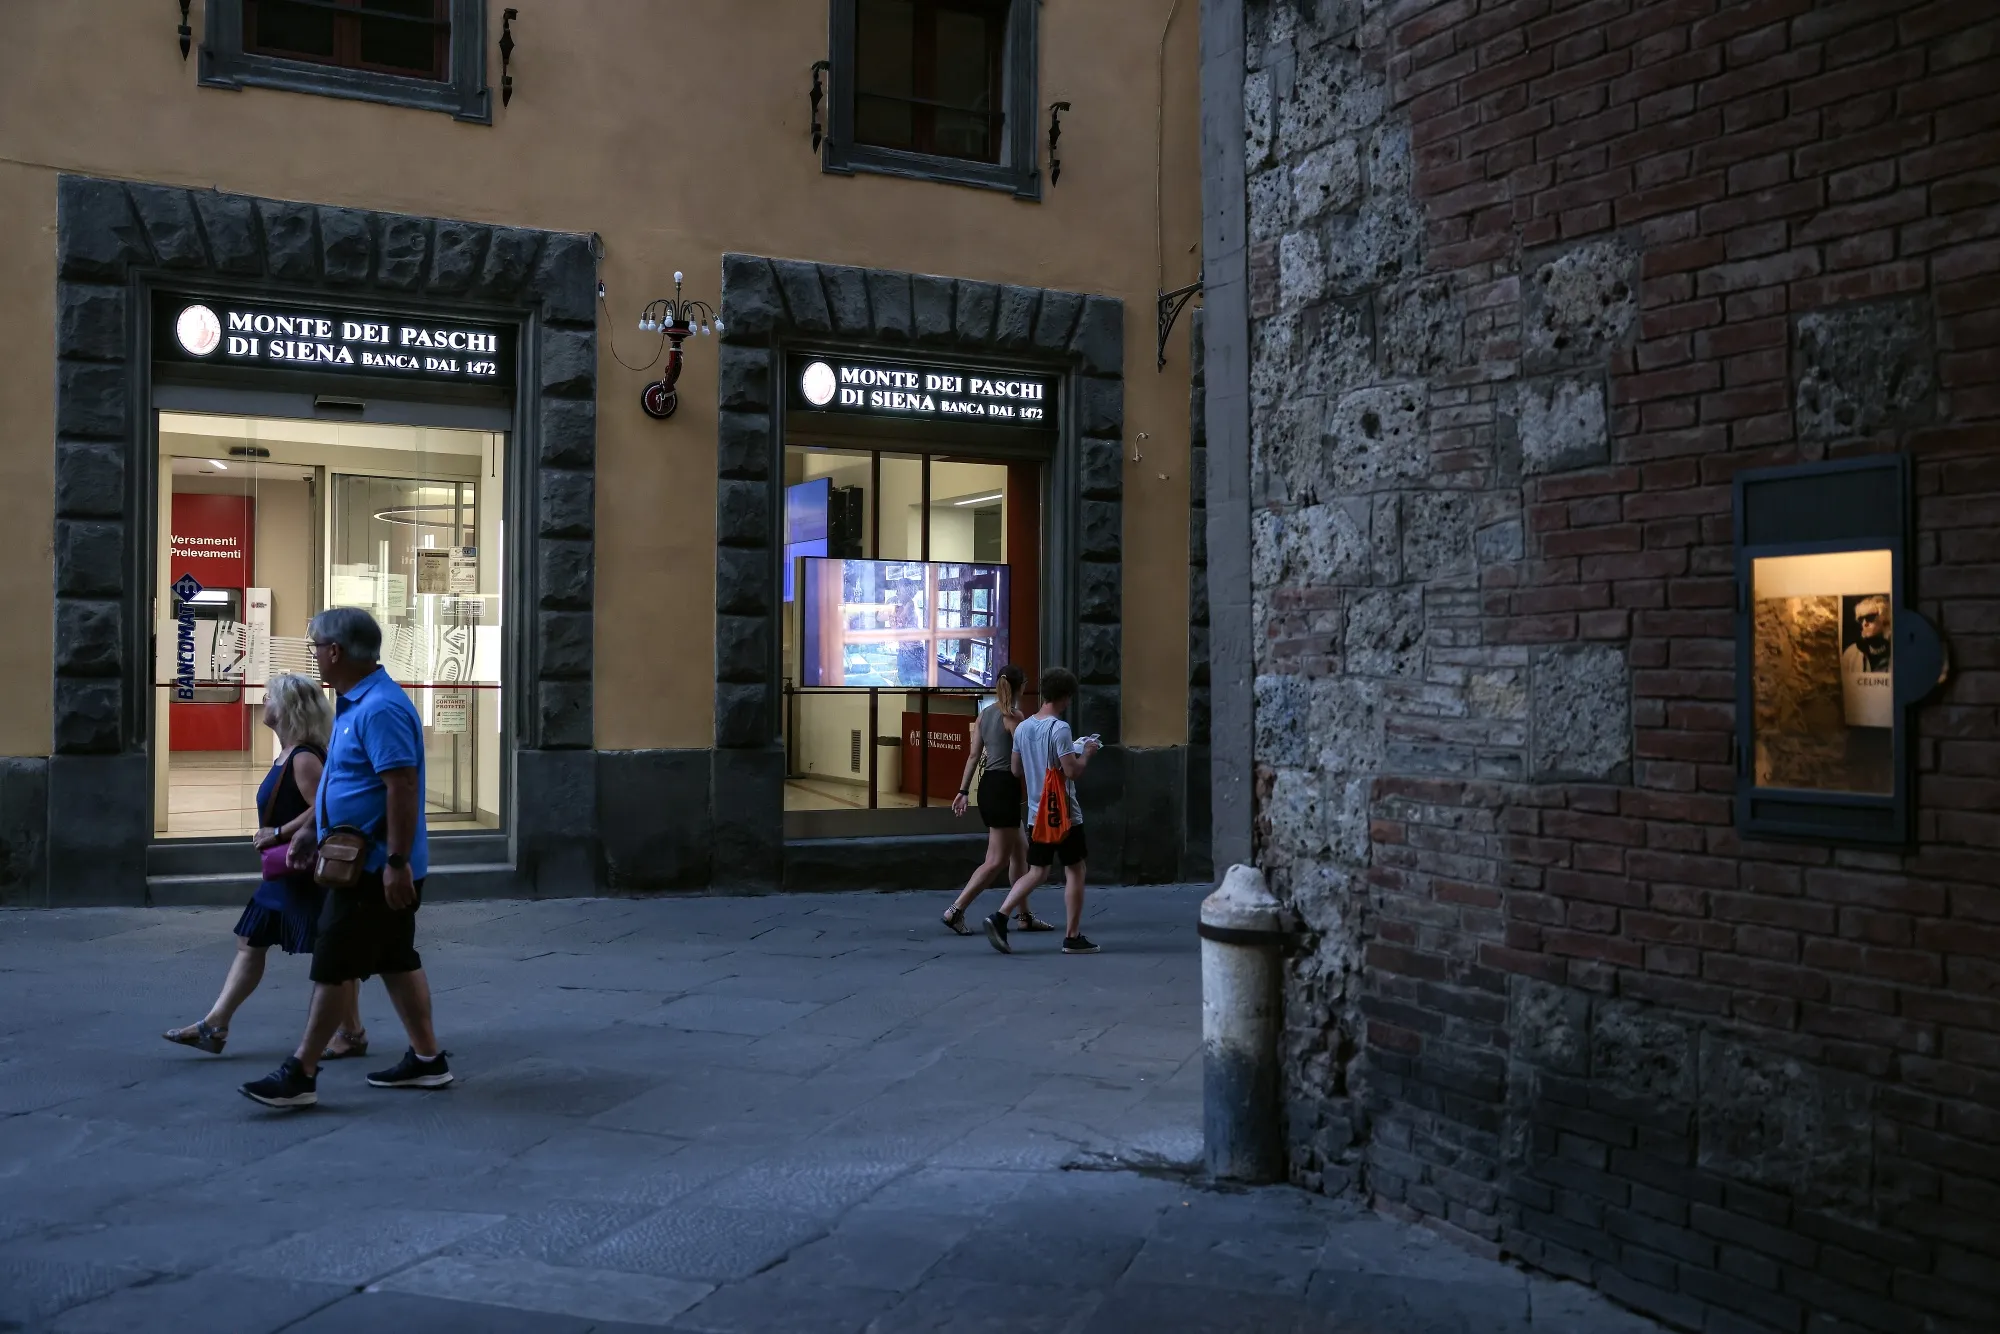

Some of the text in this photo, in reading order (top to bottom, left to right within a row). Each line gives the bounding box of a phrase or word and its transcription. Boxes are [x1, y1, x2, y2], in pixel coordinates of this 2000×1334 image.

[228, 312, 497, 352] MONTE DEI PASCHI
[228, 336, 497, 375] DI SIENA BANCA DAL 1472
[840, 367, 1043, 400] MONTE DEI PASCHI
[840, 388, 1043, 420] DI SIENA BANCA DAL 1472
[170, 534, 237, 546] Versamenti
[170, 547, 241, 559] Prelevamenti
[177, 602, 196, 700] BANCOMAT
[1857, 677, 1890, 687] CELINE
